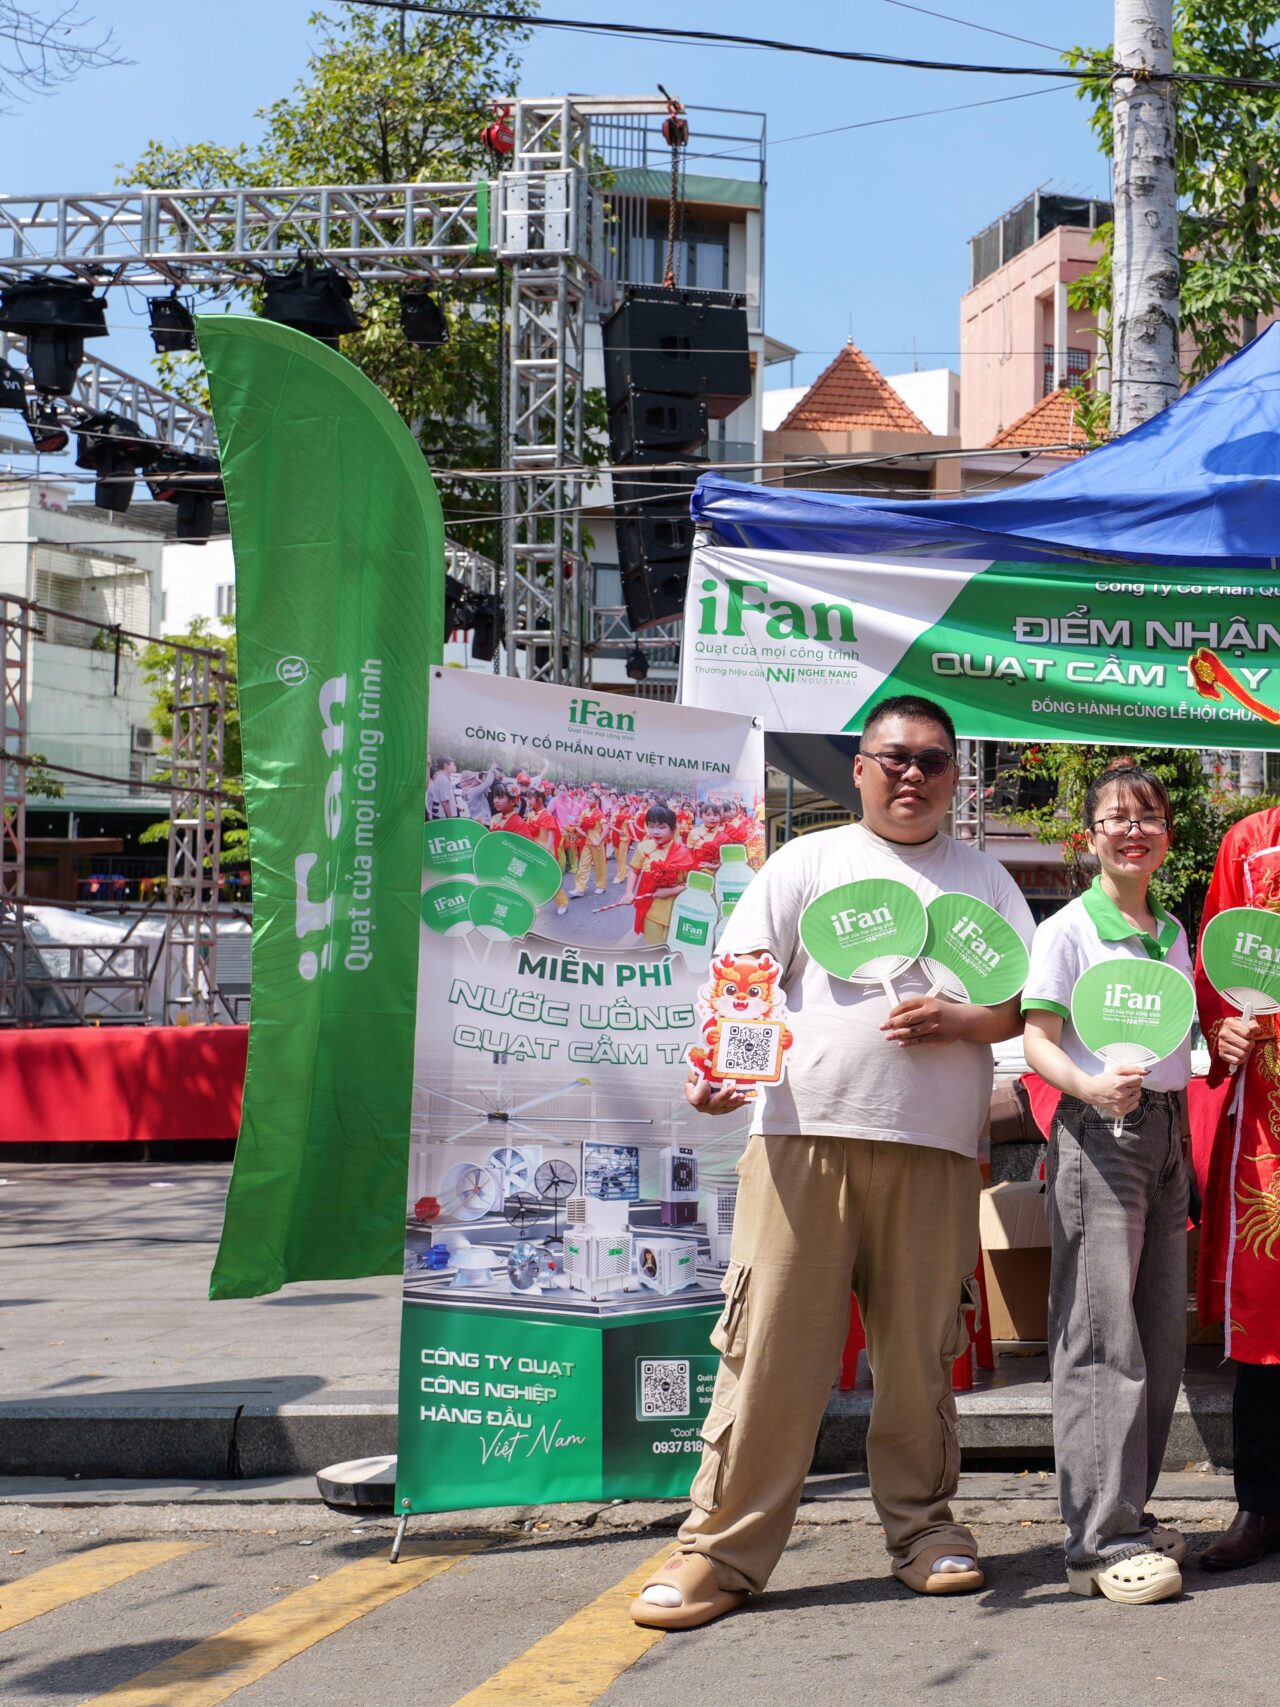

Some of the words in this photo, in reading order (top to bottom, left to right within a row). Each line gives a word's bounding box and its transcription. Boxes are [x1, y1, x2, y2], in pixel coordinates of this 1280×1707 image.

[698, 579, 858, 643] iFan
[1012, 605, 1130, 646] ĐIỂM
[695, 642, 727, 656] Quạt
[732, 644, 757, 656] của
[761, 648, 786, 660] mọi
[790, 648, 823, 662] công
[828, 648, 859, 661] trình
[358, 658, 382, 719] trình
[828, 670, 858, 679] NANG
[932, 653, 1053, 685] QUẠT
[1177, 666, 1270, 690] TY
[569, 698, 635, 733] iFan
[1031, 696, 1075, 714] ĐỒNG
[1078, 700, 1121, 716] HÀNH
[1124, 702, 1168, 718] CÙNG
[1191, 704, 1216, 722] HỘI
[353, 729, 385, 792] công
[465, 725, 506, 743] CÔNG
[511, 733, 528, 746] TY
[597, 746, 632, 762] QUẠT
[636, 751, 665, 766] VIỆT
[668, 756, 699, 770] NAM
[702, 760, 731, 774] IFAN
[351, 799, 382, 847] mọi
[428, 836, 472, 855] iFan
[345, 854, 374, 902] của
[344, 906, 375, 972] Quạt
[831, 907, 893, 936] iFan
[952, 916, 1001, 968] iFan
[518, 948, 604, 986] MIỄN
[616, 957, 672, 987] PHÍ
[449, 978, 569, 1026] NƯỚC
[580, 996, 695, 1030] UỐNG
[1104, 983, 1161, 1010] iFan
[453, 1024, 559, 1061] QUẠT
[421, 1346, 480, 1368] CÔNG
[484, 1355, 512, 1371] TY
[518, 1358, 575, 1379] QUẠT
[420, 1375, 480, 1396] CÔNG
[485, 1382, 557, 1405] NGHIỆP
[420, 1403, 482, 1424] HÀNG
[487, 1406, 533, 1429] ĐẦU
[480, 1429, 529, 1465] Việt
[526, 1419, 586, 1458] Nam
[652, 1441, 682, 1454] 0937
[684, 1440, 703, 1453] 818
